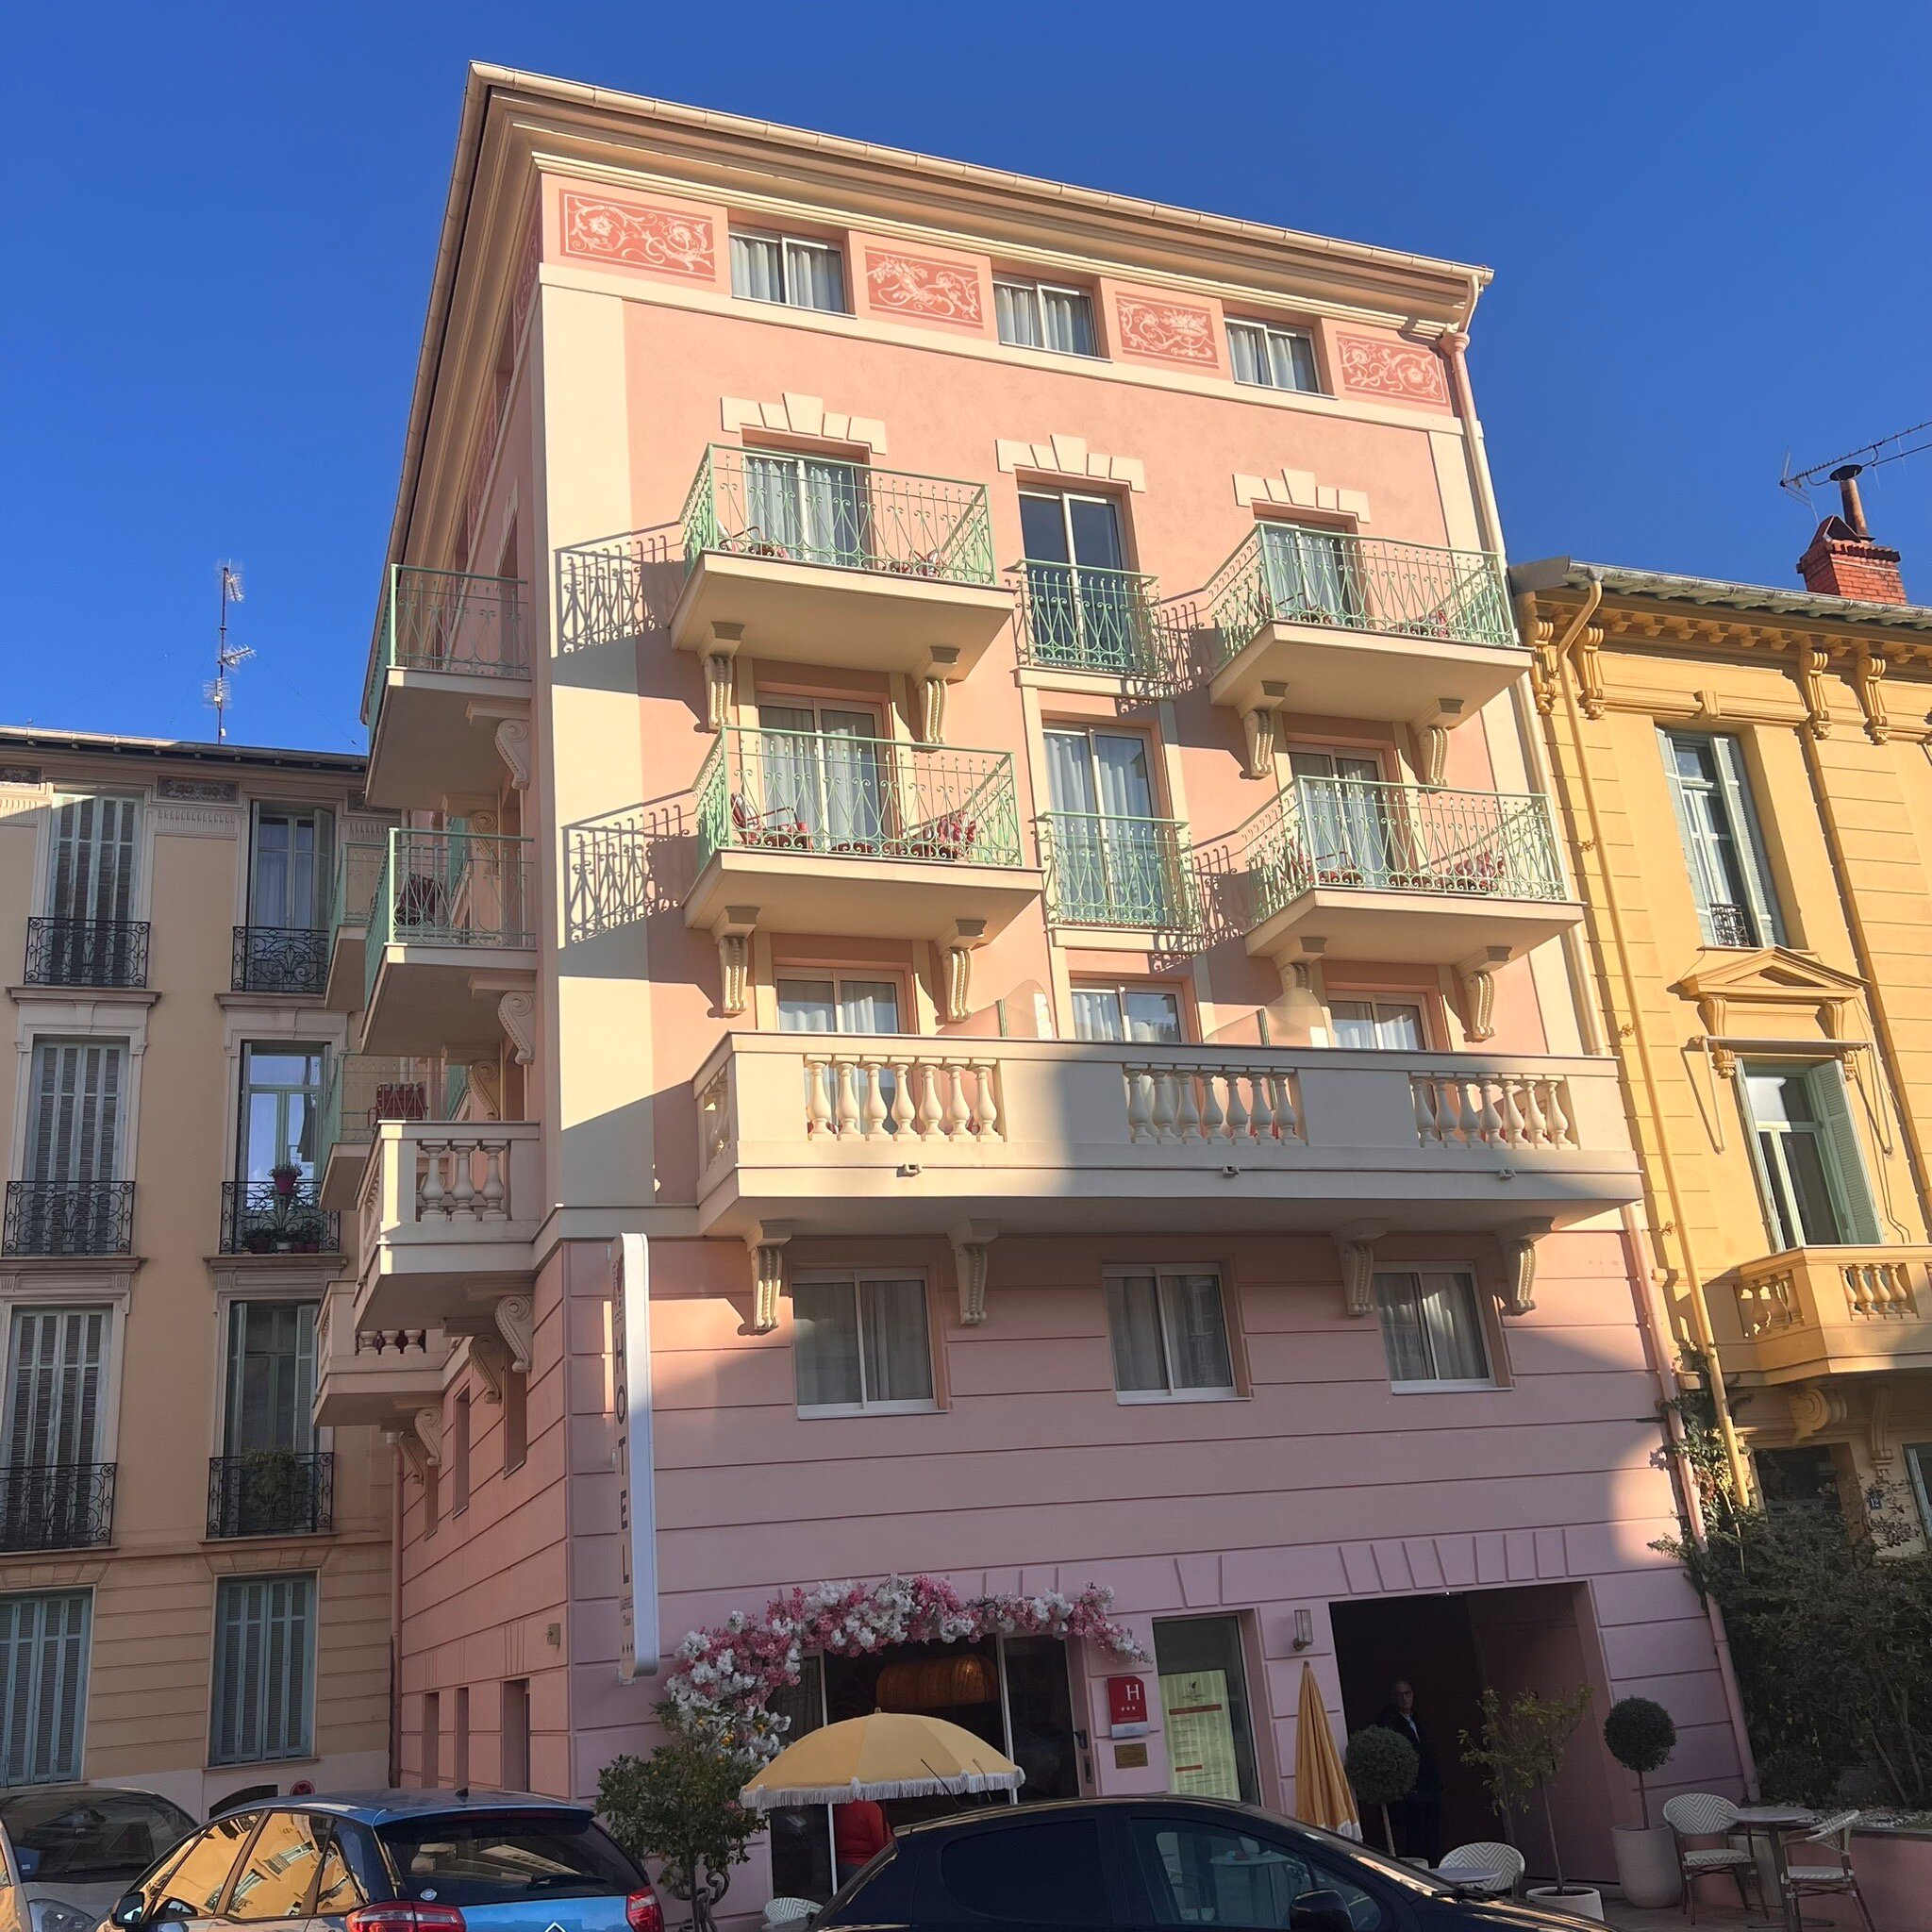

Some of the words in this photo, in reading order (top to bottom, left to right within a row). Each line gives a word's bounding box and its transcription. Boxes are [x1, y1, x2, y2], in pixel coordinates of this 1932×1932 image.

[615, 1332, 629, 1585] HOTEL
[1870, 1497, 1880, 1507] 12
[1125, 1684, 1141, 1701] H
